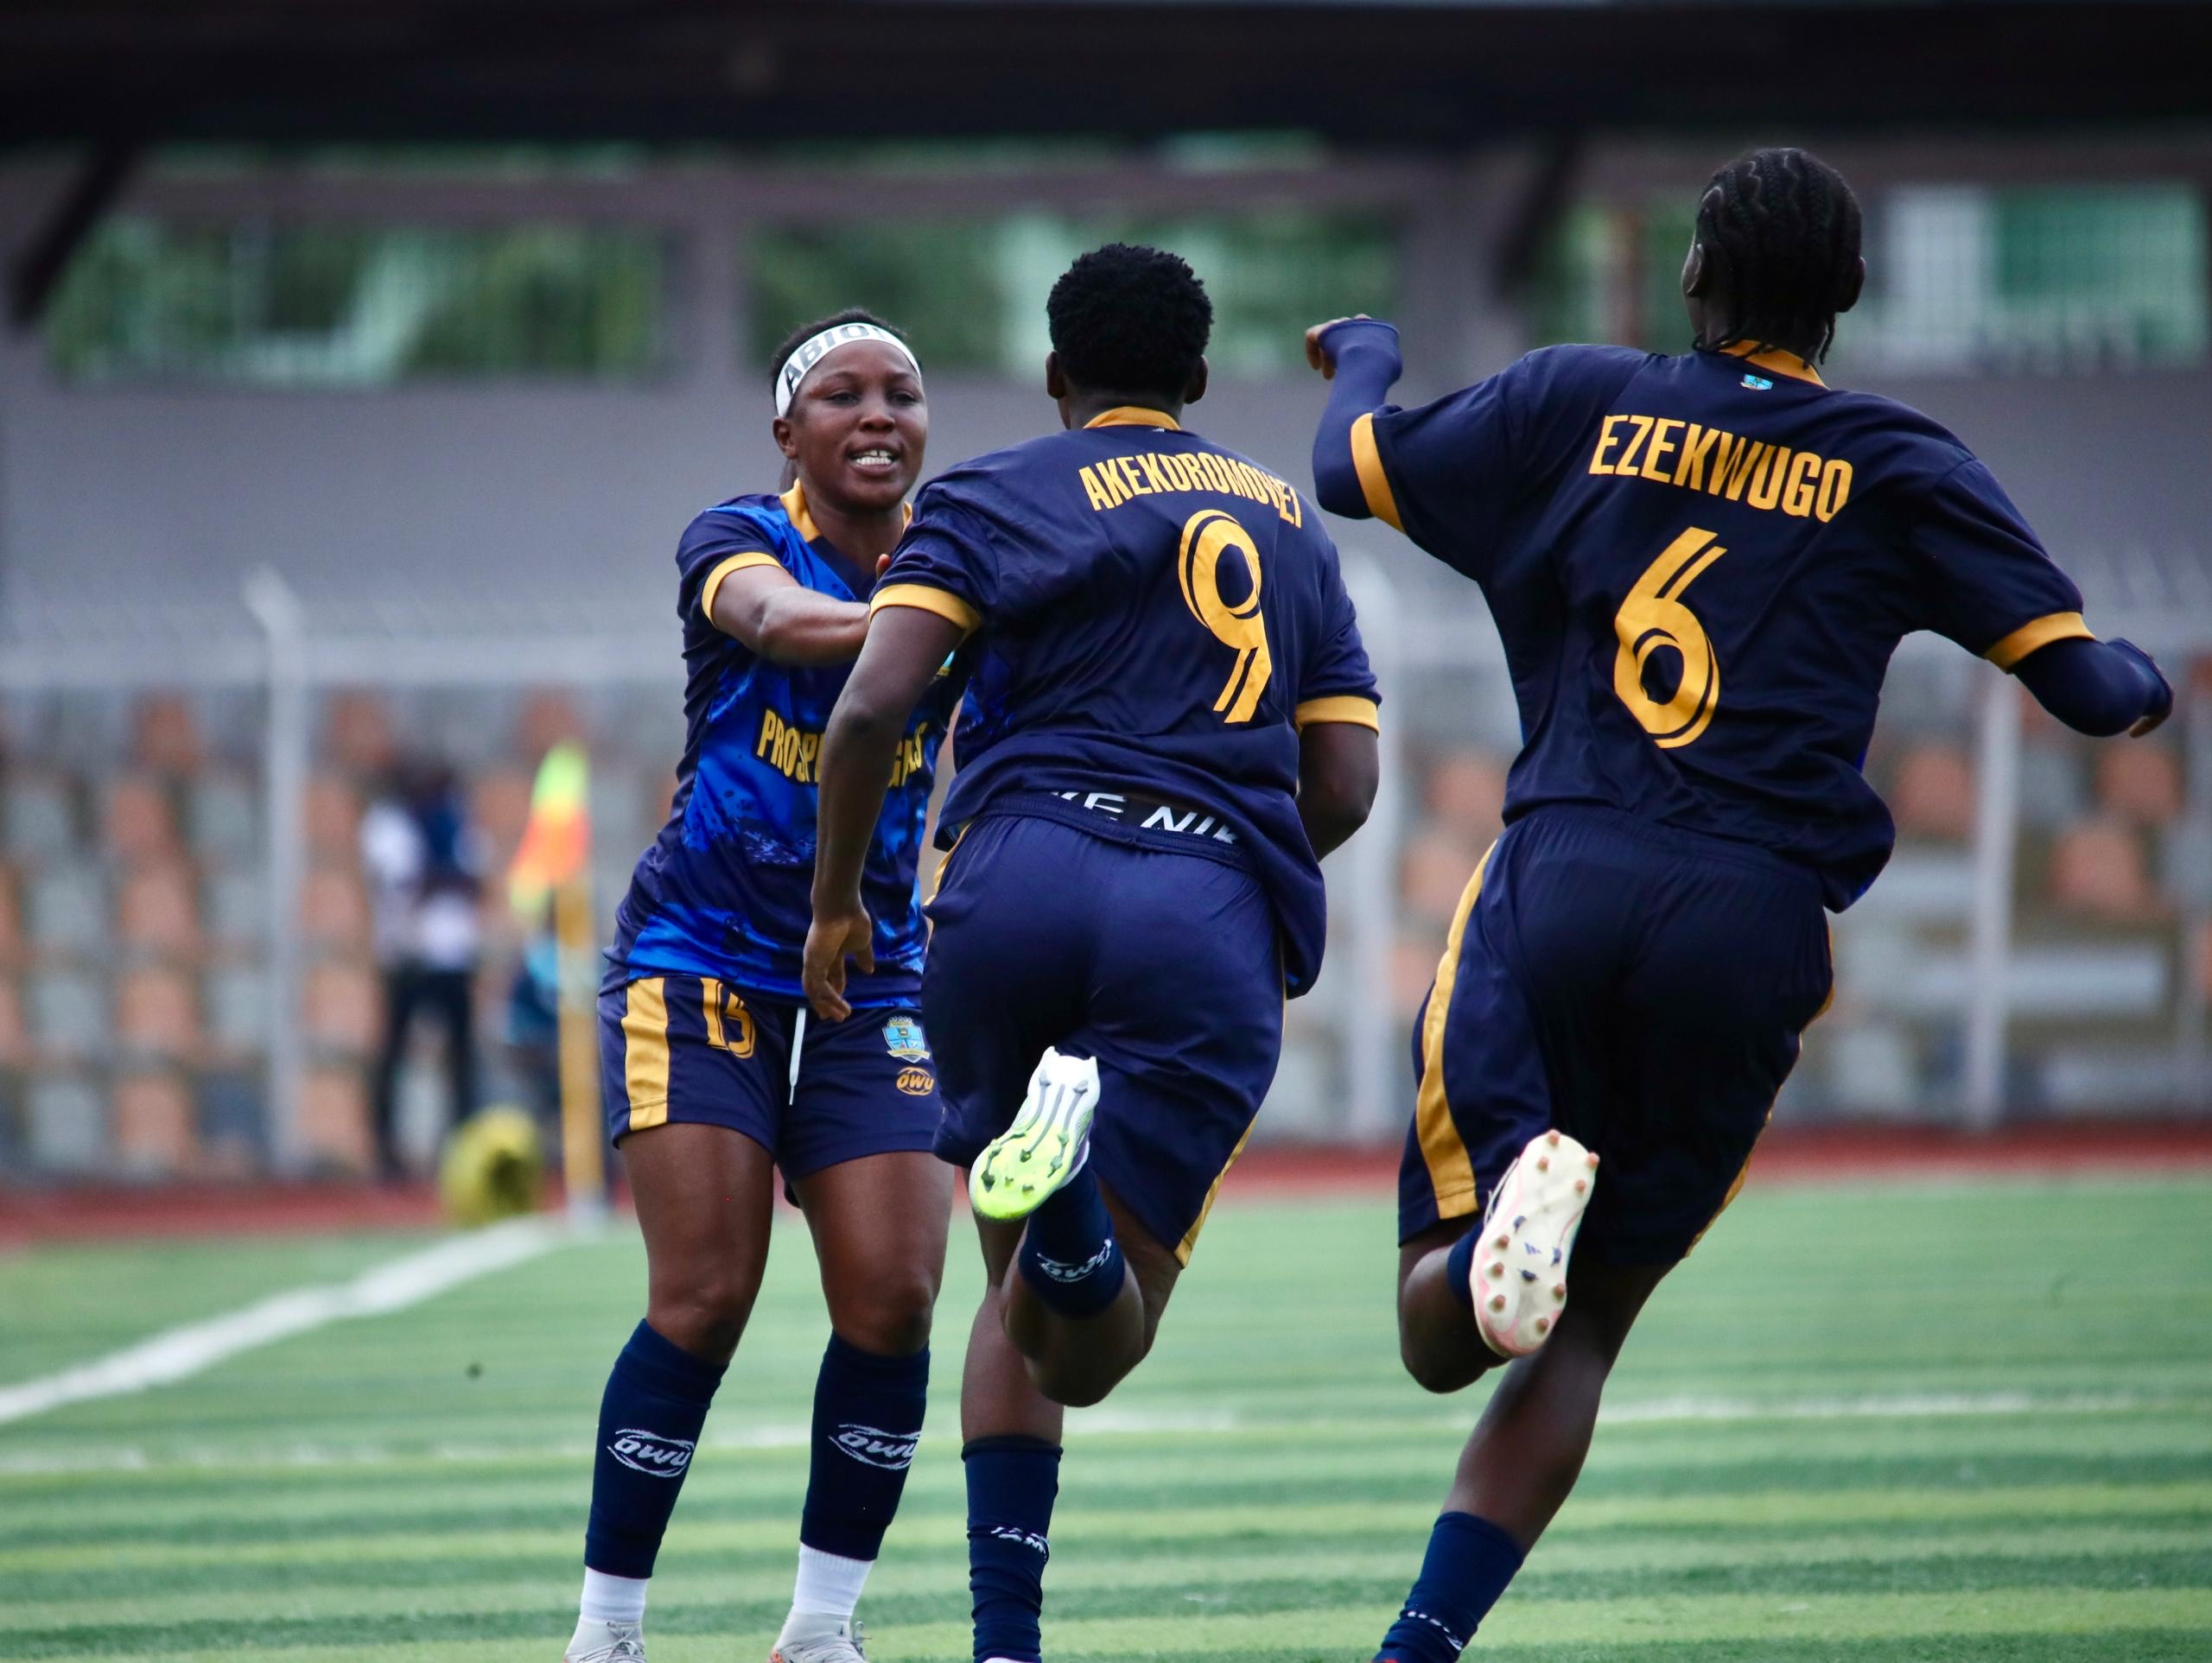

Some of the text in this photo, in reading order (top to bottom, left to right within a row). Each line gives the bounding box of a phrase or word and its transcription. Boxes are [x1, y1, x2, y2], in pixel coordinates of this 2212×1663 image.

[1588, 414, 1854, 524] EZEKWUGO
[1178, 509, 1272, 724] 9
[1613, 526, 1728, 749] 6
